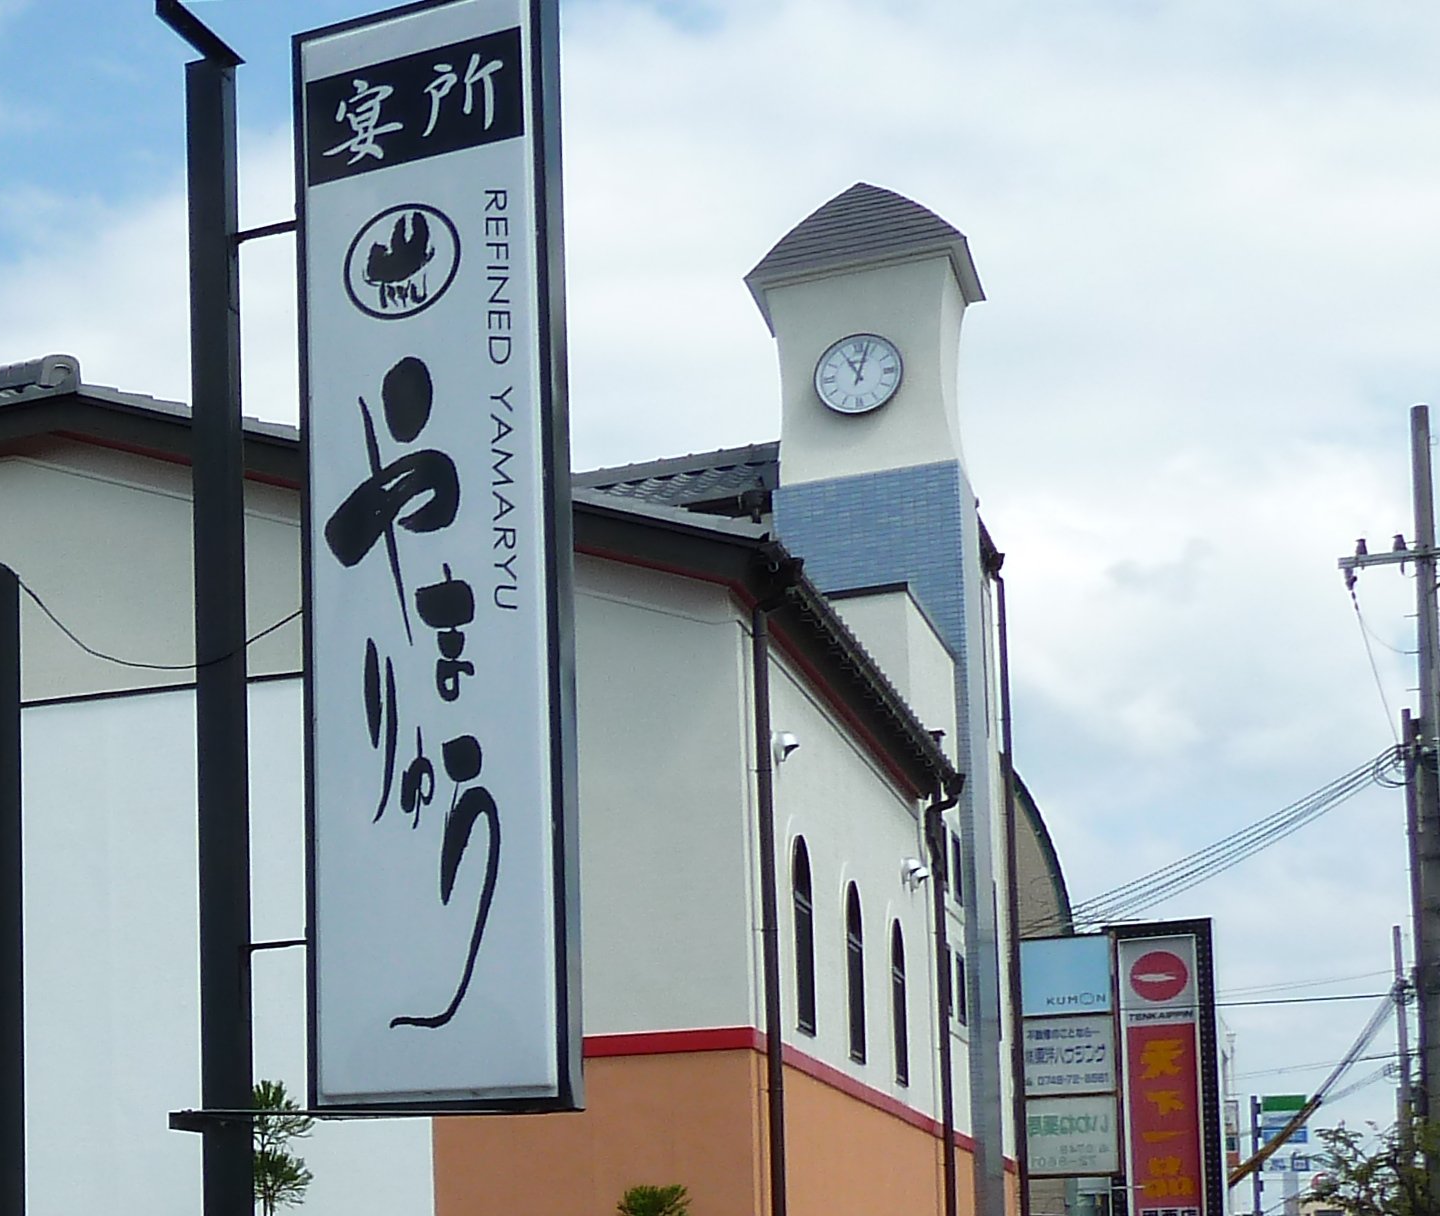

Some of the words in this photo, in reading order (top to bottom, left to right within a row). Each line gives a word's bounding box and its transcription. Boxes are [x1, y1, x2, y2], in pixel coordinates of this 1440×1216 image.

[322, 52, 505, 166] 宴所
[482, 188, 512, 366] REFINED
[487, 385, 520, 612] YAMARYU
[324, 355, 501, 1030] やまりゅう
[1046, 992, 1106, 1006] KUMON
[1140, 1038, 1195, 1198] 天下一品
